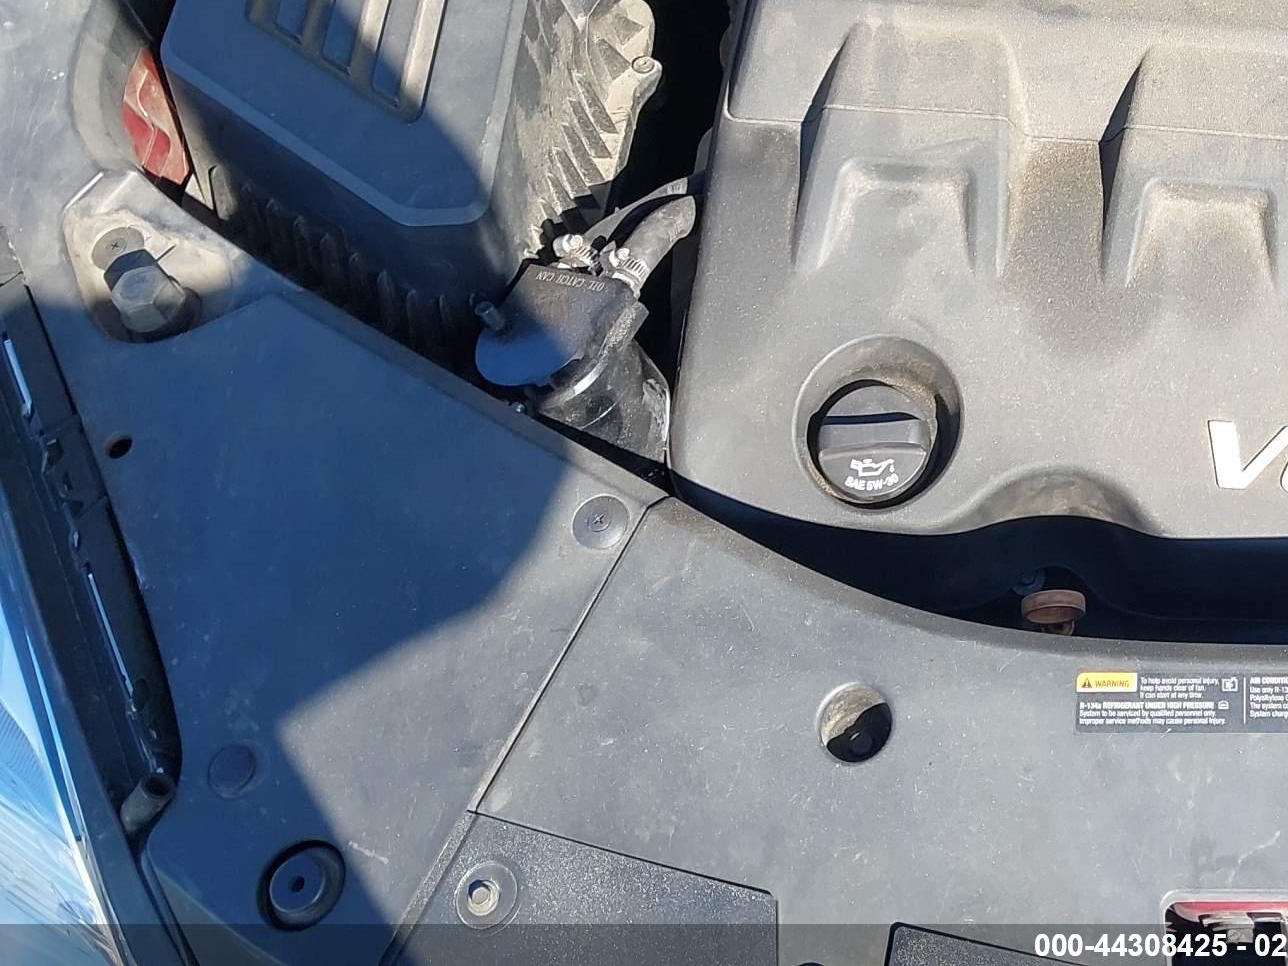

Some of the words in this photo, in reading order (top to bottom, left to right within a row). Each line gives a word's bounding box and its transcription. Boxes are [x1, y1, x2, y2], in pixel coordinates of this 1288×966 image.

[536, 271, 555, 282] CAN
[556, 274, 585, 288] CATCH
[588, 280, 605, 292] OIL
[844, 476, 866, 490] SAE
